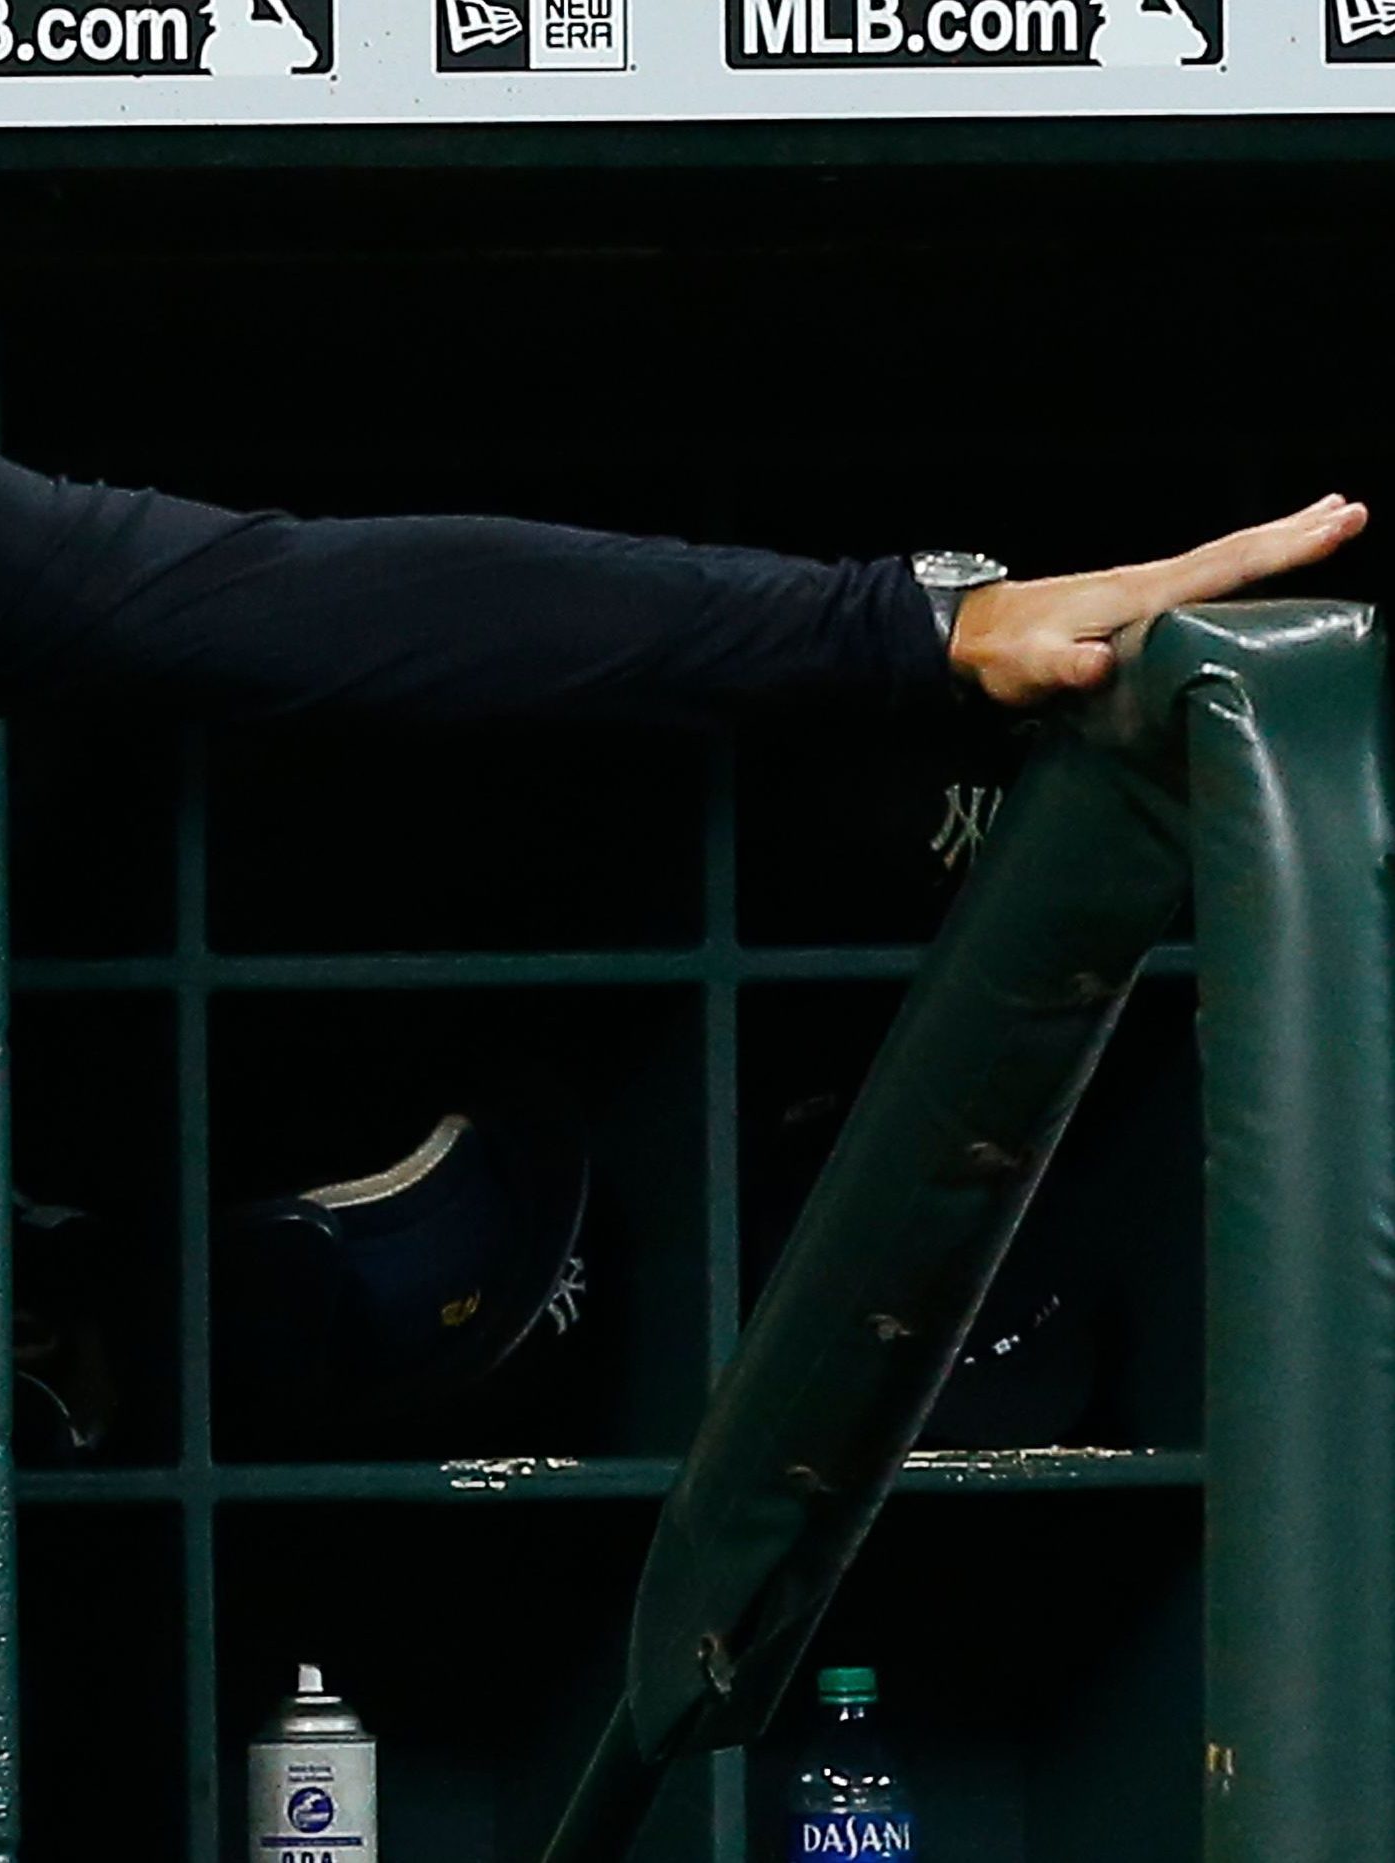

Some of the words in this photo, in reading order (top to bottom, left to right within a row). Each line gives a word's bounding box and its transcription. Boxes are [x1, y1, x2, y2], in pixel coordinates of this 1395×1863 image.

[545, 0, 612, 19] NEW
[742, 0, 1079, 55] MLB.com
[545, 22, 612, 48] ERA
[802, 1815, 911, 1861] DASANI
